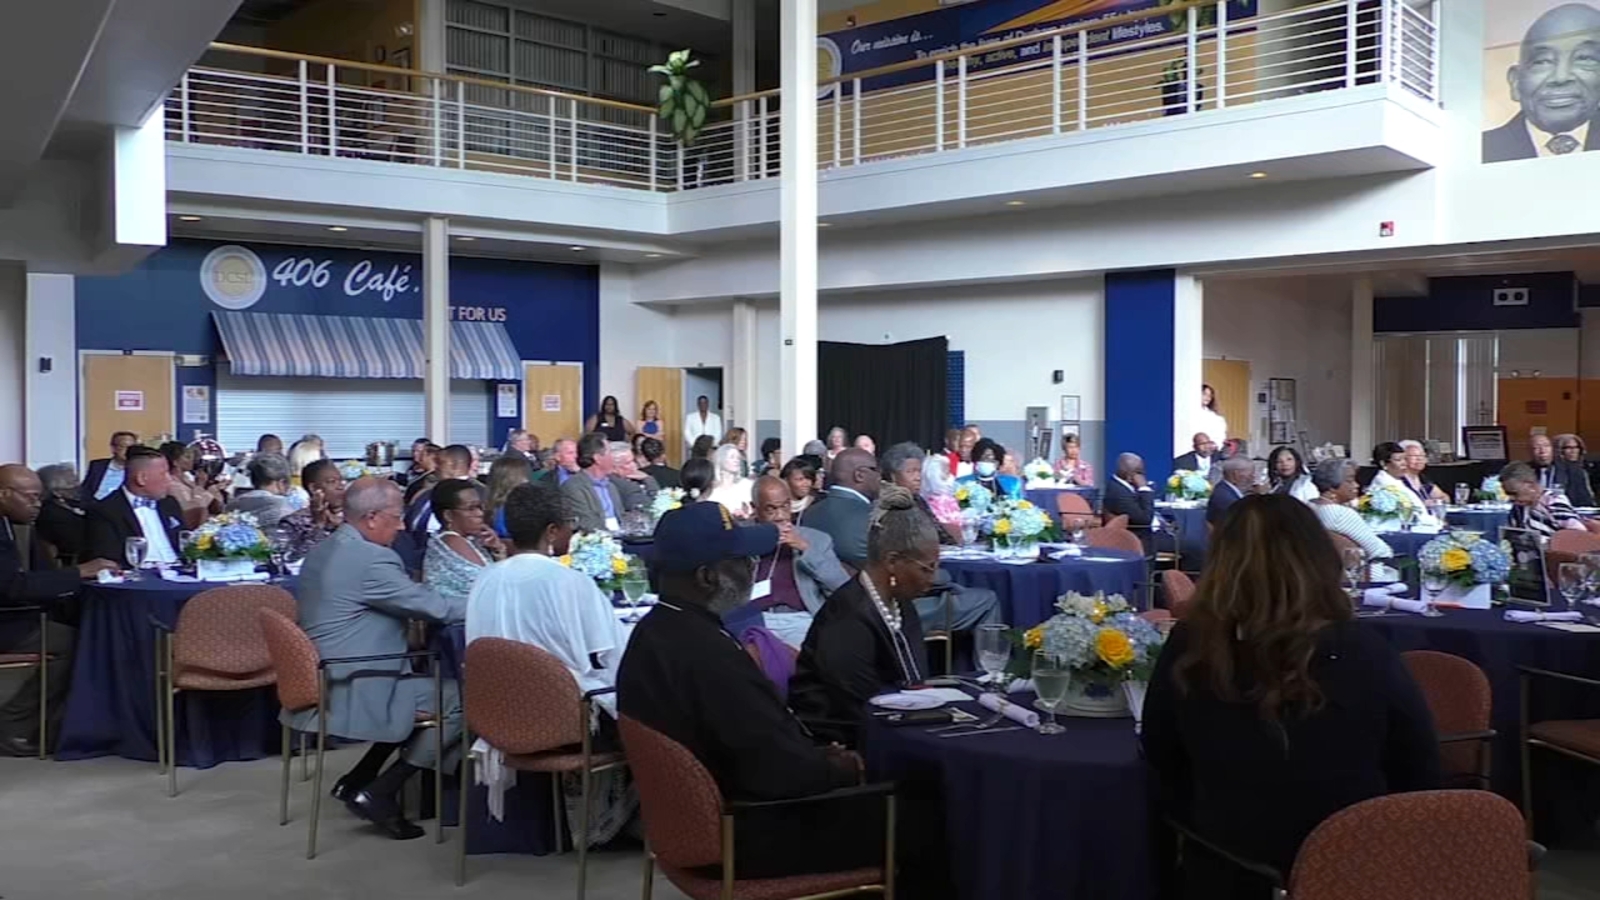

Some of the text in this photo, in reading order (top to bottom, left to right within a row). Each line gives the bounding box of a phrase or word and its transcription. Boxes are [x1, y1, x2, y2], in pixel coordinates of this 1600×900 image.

[1020, 43, 1040, 57] and
[272, 257, 333, 288] 406
[458, 306, 486, 321] FOR
[488, 307, 506, 322] US
